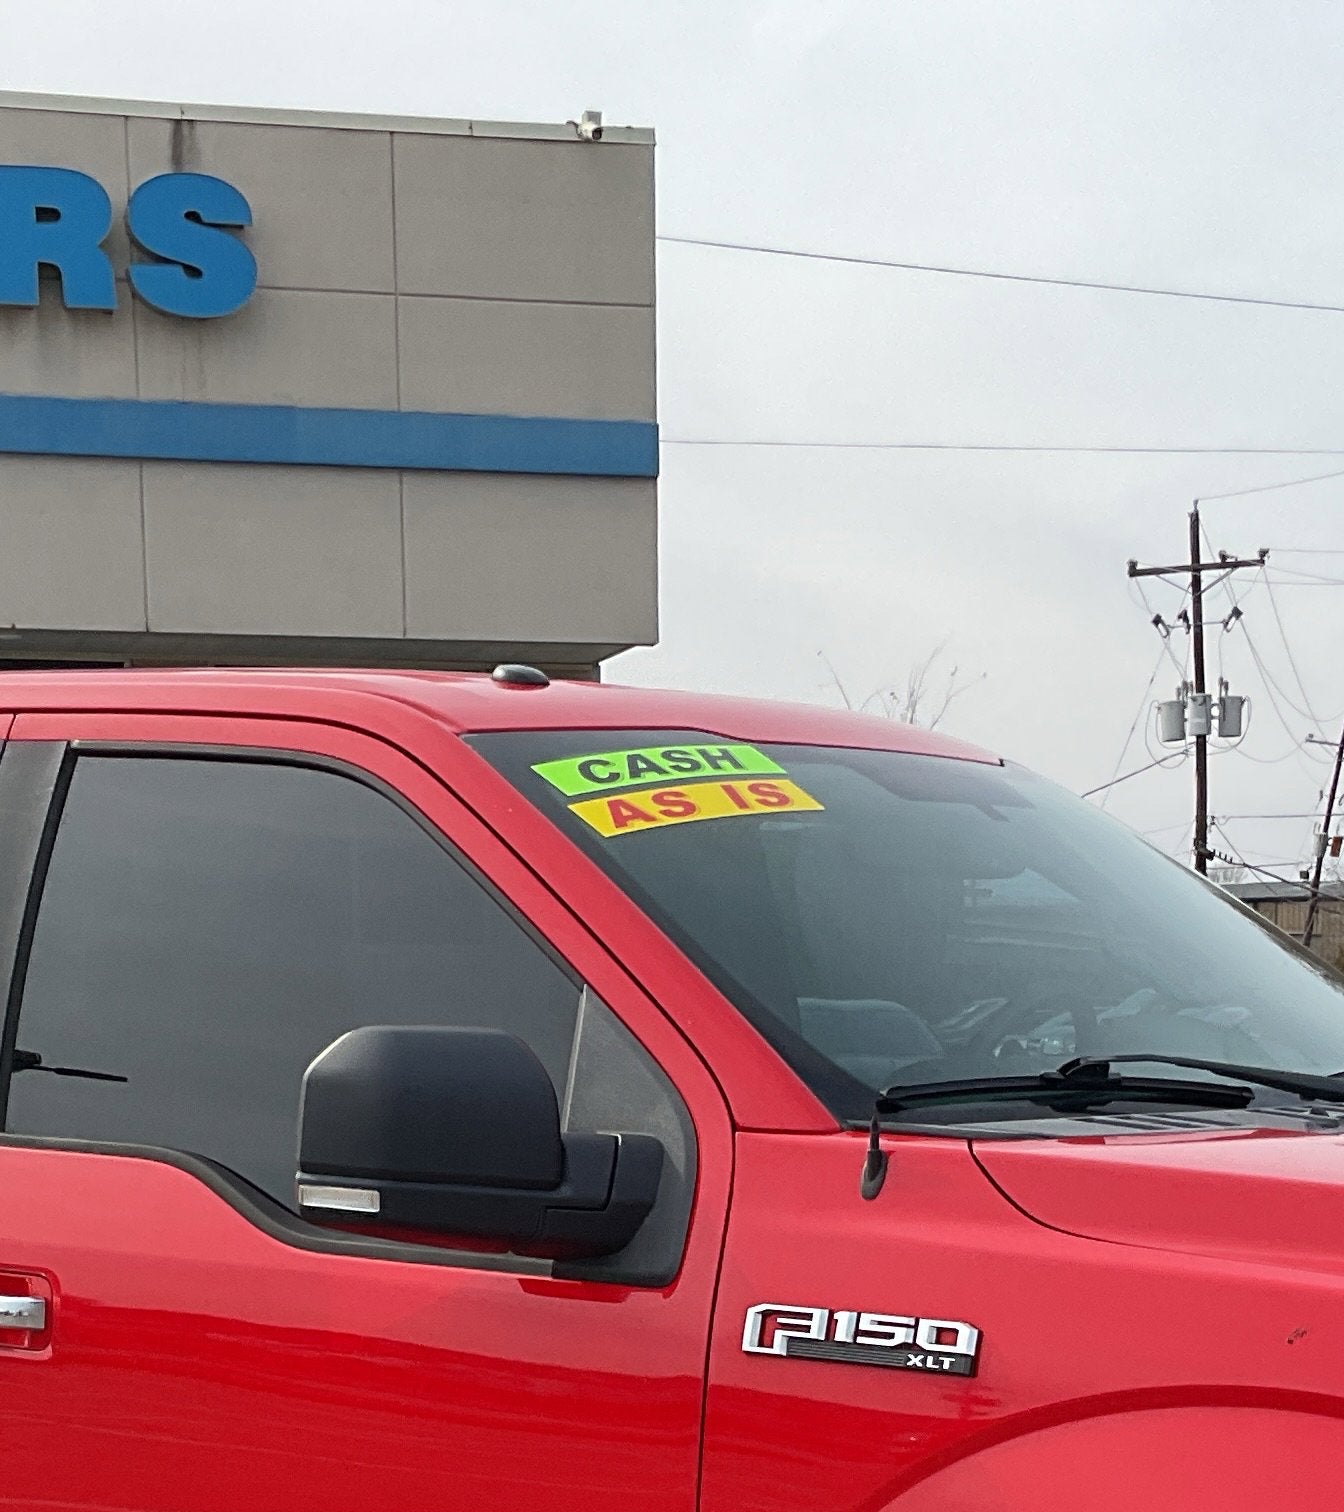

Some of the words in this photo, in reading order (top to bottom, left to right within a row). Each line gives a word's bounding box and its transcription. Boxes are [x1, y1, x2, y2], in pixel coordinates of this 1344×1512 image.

[577, 747, 745, 784] CASH
[606, 791, 699, 829] AS
[720, 782, 794, 810] IS
[907, 1353, 956, 1370] XLT
